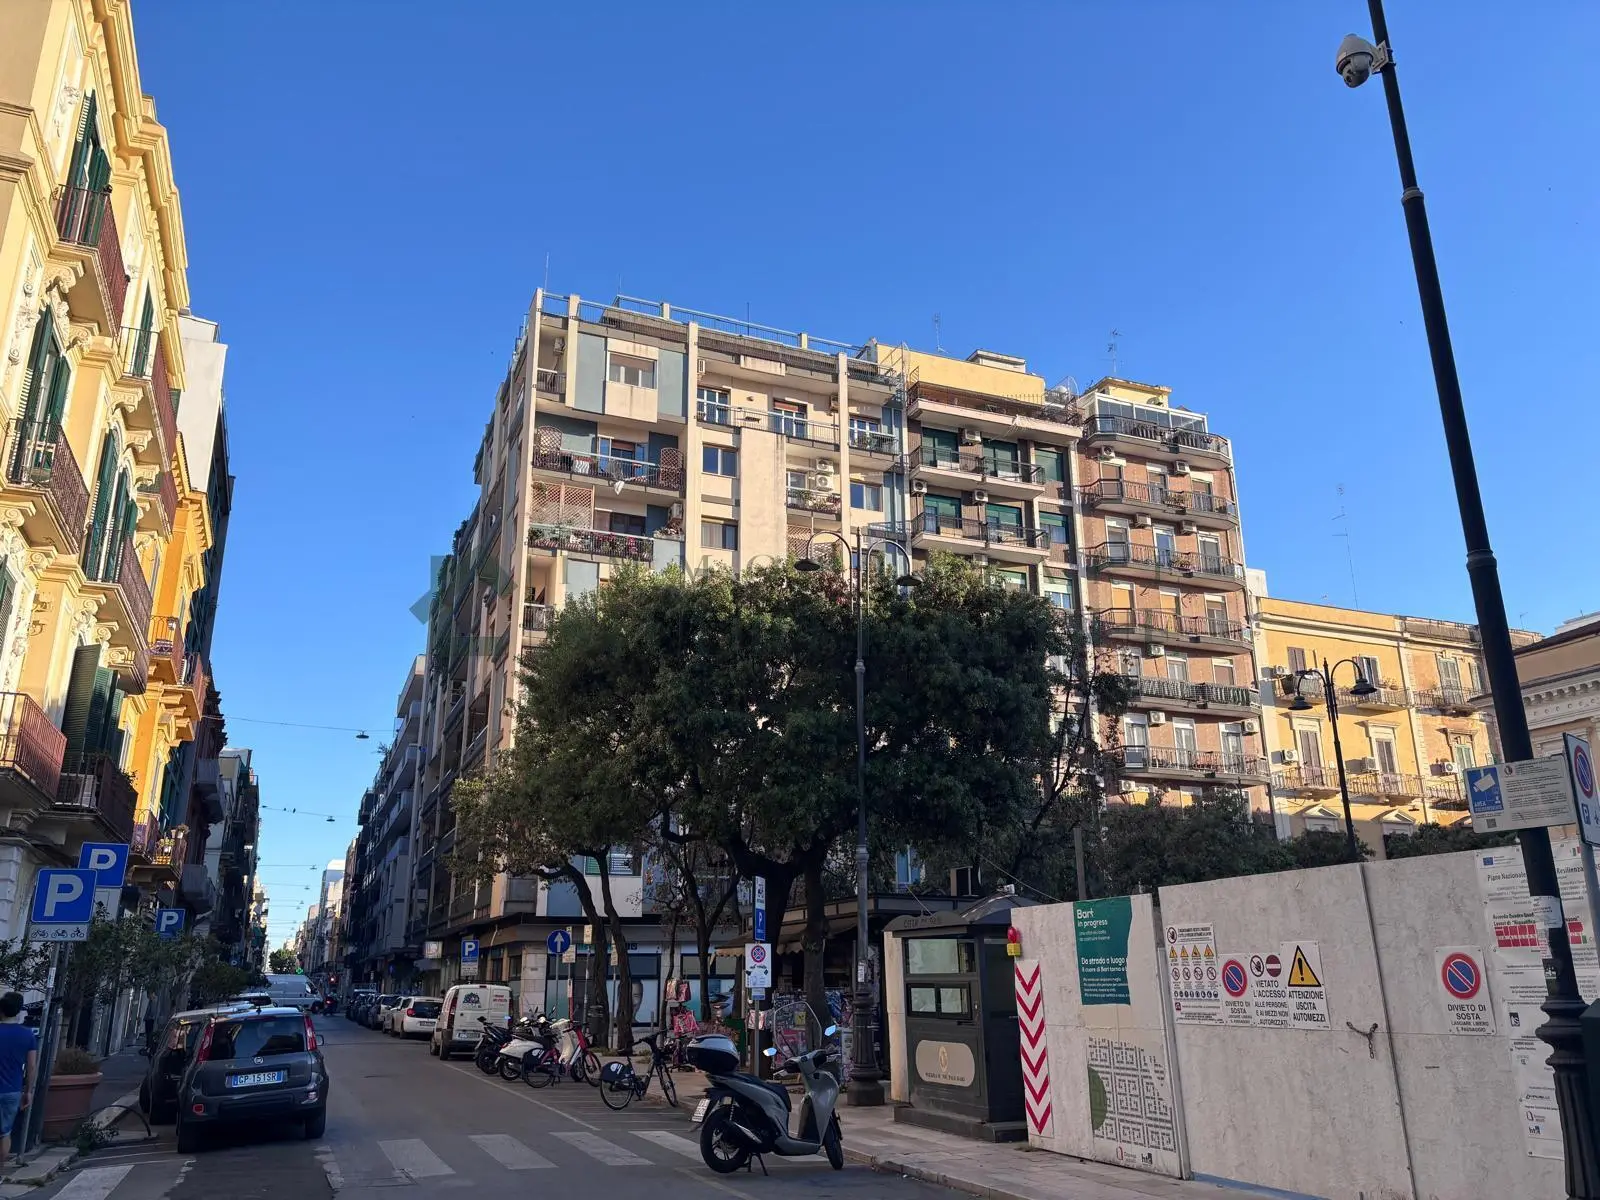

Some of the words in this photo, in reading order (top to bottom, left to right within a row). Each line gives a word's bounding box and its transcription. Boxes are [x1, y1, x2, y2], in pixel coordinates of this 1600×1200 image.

[43, 874, 84, 917] P
[160, 911, 179, 932] P
[1083, 919, 1108, 929] progress
[464, 941, 476, 956] P
[1081, 957, 1088, 965] Da
[1089, 957, 1105, 965] strada
[1111, 956, 1125, 966] luogo
[1256, 980, 1279, 988] VIETATO
[1253, 989, 1286, 998] L'ACCESSO
[1288, 990, 1324, 1000] ATTENZIONE
[1266, 1001, 1288, 1009] PERSONE
[1295, 1001, 1317, 1011] USCITA
[1447, 1004, 1476, 1012] DIVIETO
[1478, 1004, 1486, 1012] DI
[1293, 1012, 1326, 1022] AUTOMEZZI
[1456, 1012, 1481, 1020] SOSTA
